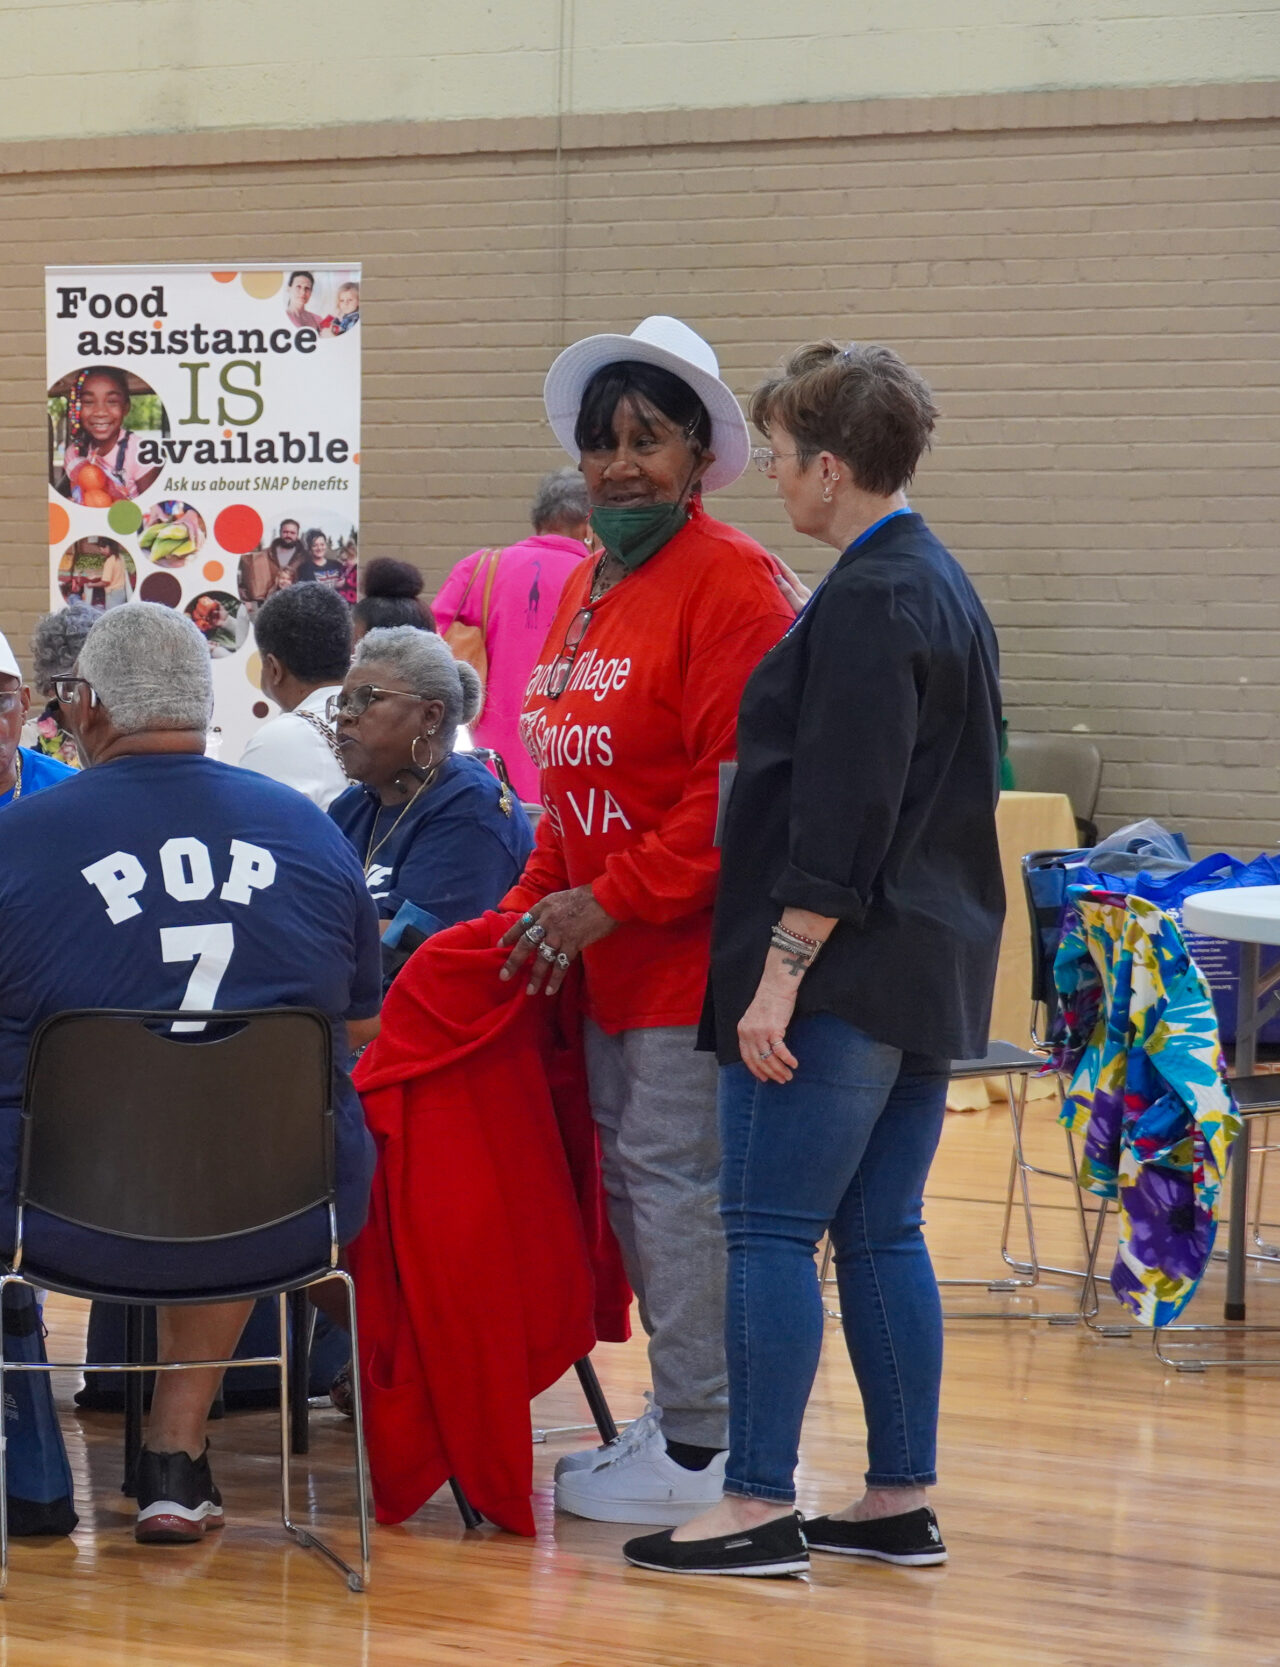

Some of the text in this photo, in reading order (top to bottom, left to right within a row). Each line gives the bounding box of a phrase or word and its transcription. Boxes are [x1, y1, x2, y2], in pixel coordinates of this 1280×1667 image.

[56, 286, 167, 319] Food
[77, 321, 318, 356] assistance
[178, 360, 264, 426] IS
[138, 429, 349, 464] available
[164, 476, 349, 491] Ask us about SNAP benefits
[536, 713, 613, 768] Seniors
[81, 837, 277, 925] POP
[160, 922, 235, 1032] 7
